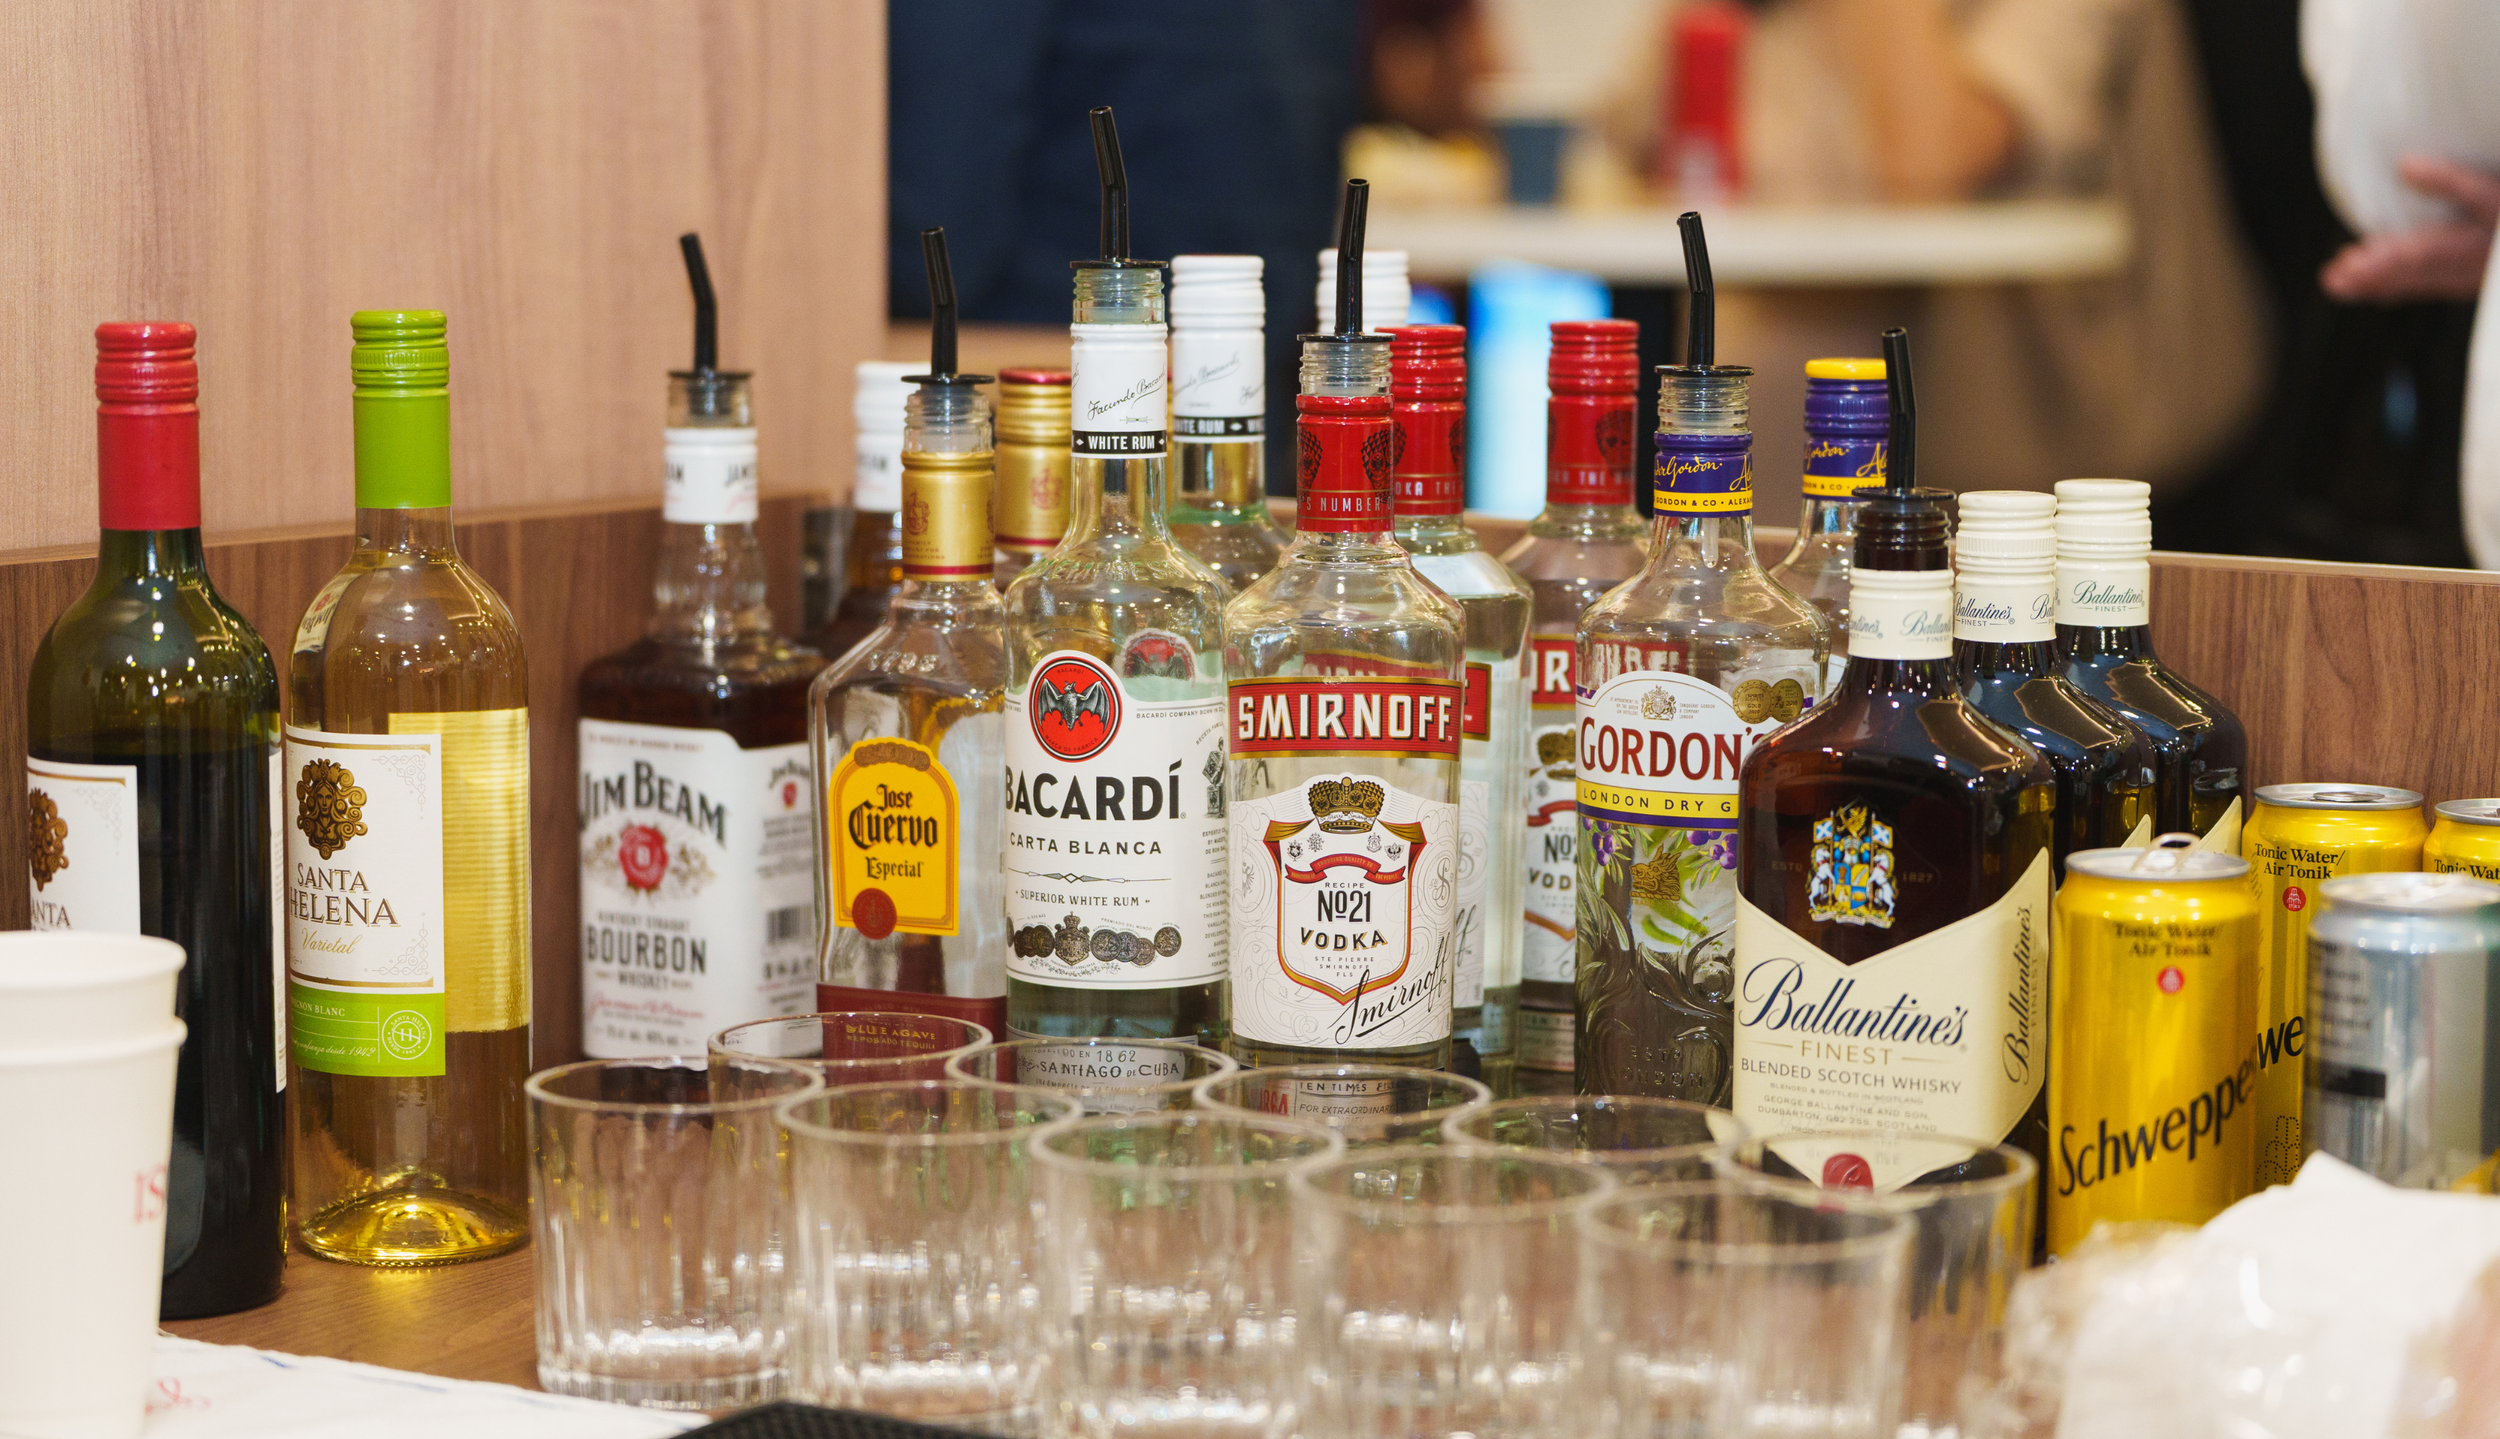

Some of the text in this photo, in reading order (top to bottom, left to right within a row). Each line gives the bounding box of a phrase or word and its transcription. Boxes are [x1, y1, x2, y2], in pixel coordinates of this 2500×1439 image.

[1175, 419, 1225, 434] HITE RUM
[1088, 435, 1155, 450] WHITE RUM
[1435, 481, 1457, 495] THE
[1320, 497, 1380, 512] NUMBER
[1656, 496, 1687, 506] GORDON
[1961, 618, 1987, 627] FINEST
[1136, 711, 1167, 719] BACARDÍ
[1169, 710, 1198, 718] COMPANY
[1238, 693, 1453, 741] SMIRNOFF
[1580, 716, 1765, 781] GORDON'
[877, 783, 913, 812] Jose
[1006, 758, 1183, 821] BACARDÍ
[1583, 787, 1649, 808] LONDON
[1665, 799, 1704, 812] DRY
[579, 760, 726, 846] JIM BEAM
[848, 800, 939, 850] Cuervo
[1010, 832, 1162, 855] CARTA BLANCA
[2255, 843, 2346, 866] Tonic Water/
[297, 863, 371, 893] SANTA
[865, 856, 922, 881] Especial
[1528, 867, 1572, 891] VOD
[2264, 862, 2333, 879] Air Tonik
[2469, 864, 2500, 880] Wat
[290, 886, 401, 927] HELENA
[1020, 889, 1140, 906] SUPERIOR WHITE RUM
[302, 927, 363, 954] Varietal
[1300, 926, 1388, 951] VODKA
[2114, 923, 2161, 940] Tonic
[587, 924, 706, 976] BOURBON
[2129, 942, 2212, 957] Air Tonik
[1328, 932, 1450, 1045] Smirnoff
[2002, 906, 2031, 1086] Ballantine's
[315, 1005, 345, 1017] BLANC
[1738, 957, 1968, 1047] Ballantine's
[391, 1016, 410, 1026] SANTA
[846, 1024, 888, 1036] BLUE
[892, 1029, 936, 1040] AGAVE
[401, 1028, 412, 1041] H
[847, 1034, 936, 1050] REPOSADO TEQUILA
[326, 1045, 376, 1057] desde 1942
[1097, 1050, 1136, 1063] 1862
[1801, 1039, 1893, 1066] FINEST
[1040, 1061, 1180, 1078] SANTIAGO DE CUBA
[1741, 1058, 1962, 1095] BLENDED SCOTCH WHISKY
[1332, 1083, 1367, 1092] TIMES
[1770, 1082, 1807, 1093] BLENDED
[1819, 1088, 1859, 1100] BOTTLED
[1874, 1094, 1923, 1105] SCOTLAND
[1300, 1104, 1392, 1115] FOR EXTRAORDINAR
[1764, 1094, 1803, 1107] GEORGE
[1807, 1099, 1874, 1114] BALLANTINE
[1877, 1107, 1900, 1117] AND
[1877, 1120, 1937, 1133] SCOTLAND
[2059, 1060, 2254, 1196] Schweppe
